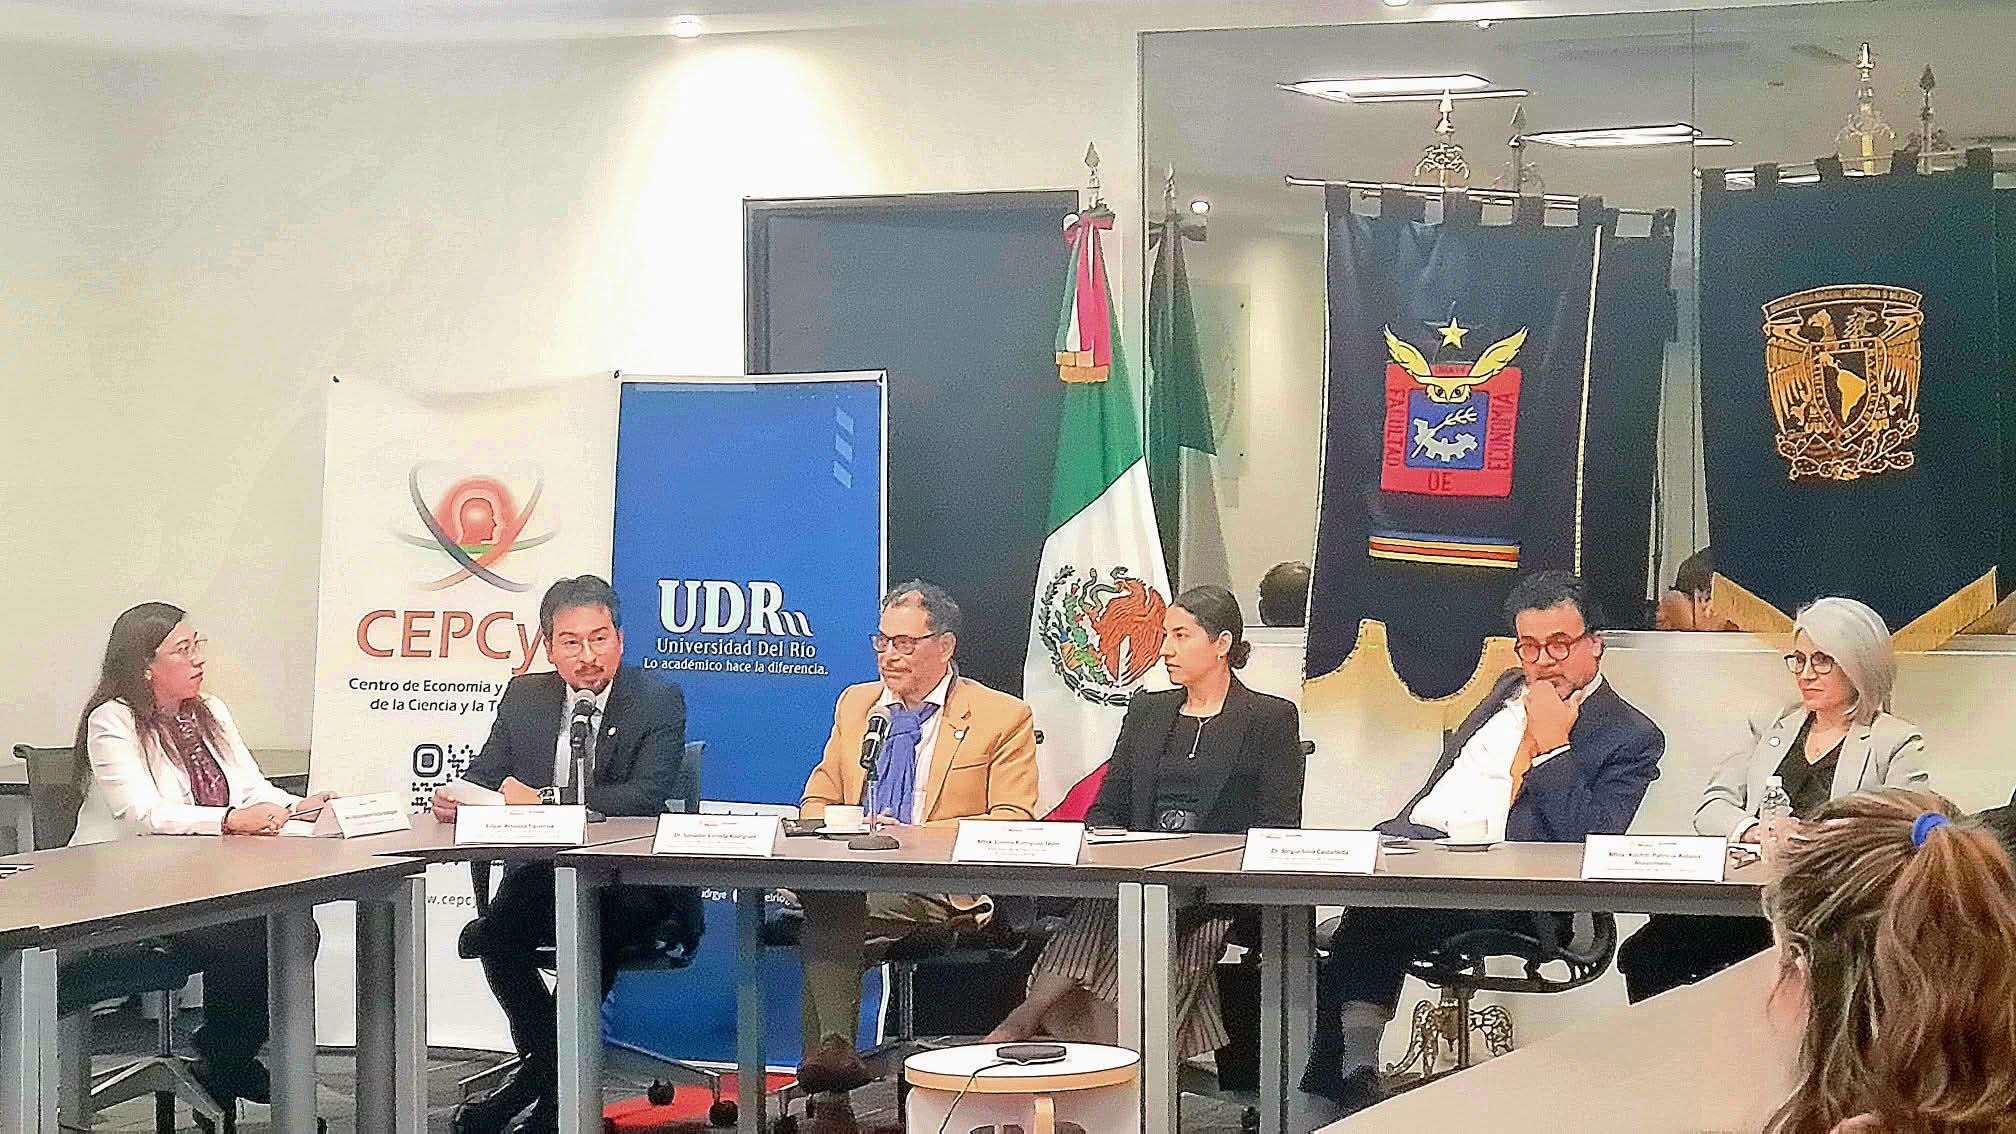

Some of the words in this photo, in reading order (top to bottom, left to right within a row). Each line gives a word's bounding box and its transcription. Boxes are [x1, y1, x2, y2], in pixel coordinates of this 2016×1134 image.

[1386, 388, 1406, 467] FACULTAD
[1428, 472, 1452, 491] DE
[657, 636, 752, 656] Universidad
[758, 641, 783, 657] Del
[790, 641, 816, 658] Río
[643, 657, 658, 669] Lo
[662, 657, 722, 671] académico
[726, 659, 751, 672] hace
[755, 660, 765, 673] la
[768, 660, 829, 676] diferencia.
[350, 678, 399, 692] Centro
[403, 679, 419, 692] de
[494, 684, 503, 696] y
[370, 698, 388, 711] de
[393, 699, 405, 711] la
[409, 699, 457, 712] Ciencia
[461, 703, 471, 716] y
[472, 700, 484, 712] la
[426, 895, 476, 908] w.cepc
